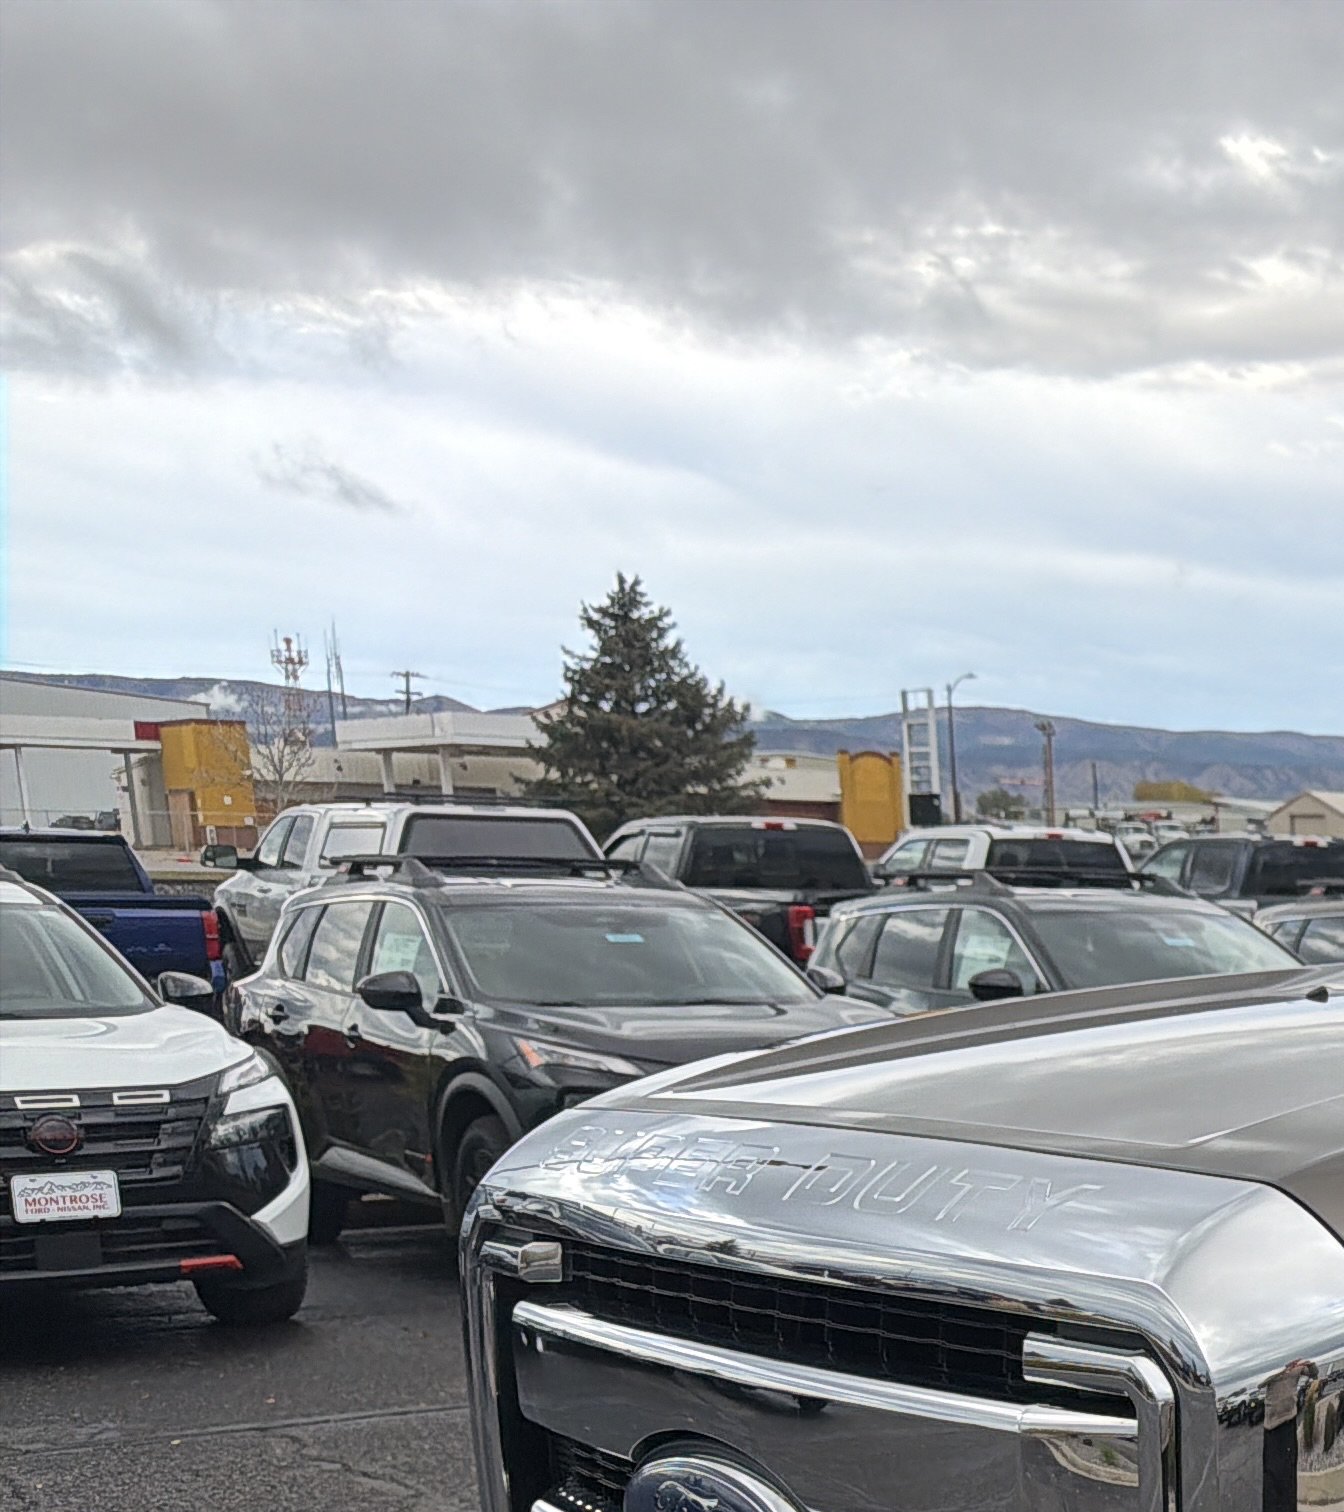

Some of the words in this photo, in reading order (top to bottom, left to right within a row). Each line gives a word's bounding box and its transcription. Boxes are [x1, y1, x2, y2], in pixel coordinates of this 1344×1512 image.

[24, 1193, 108, 1209] MONTROSE
[540, 1125, 779, 1196] SUPER
[783, 1152, 1105, 1232] DUTY
